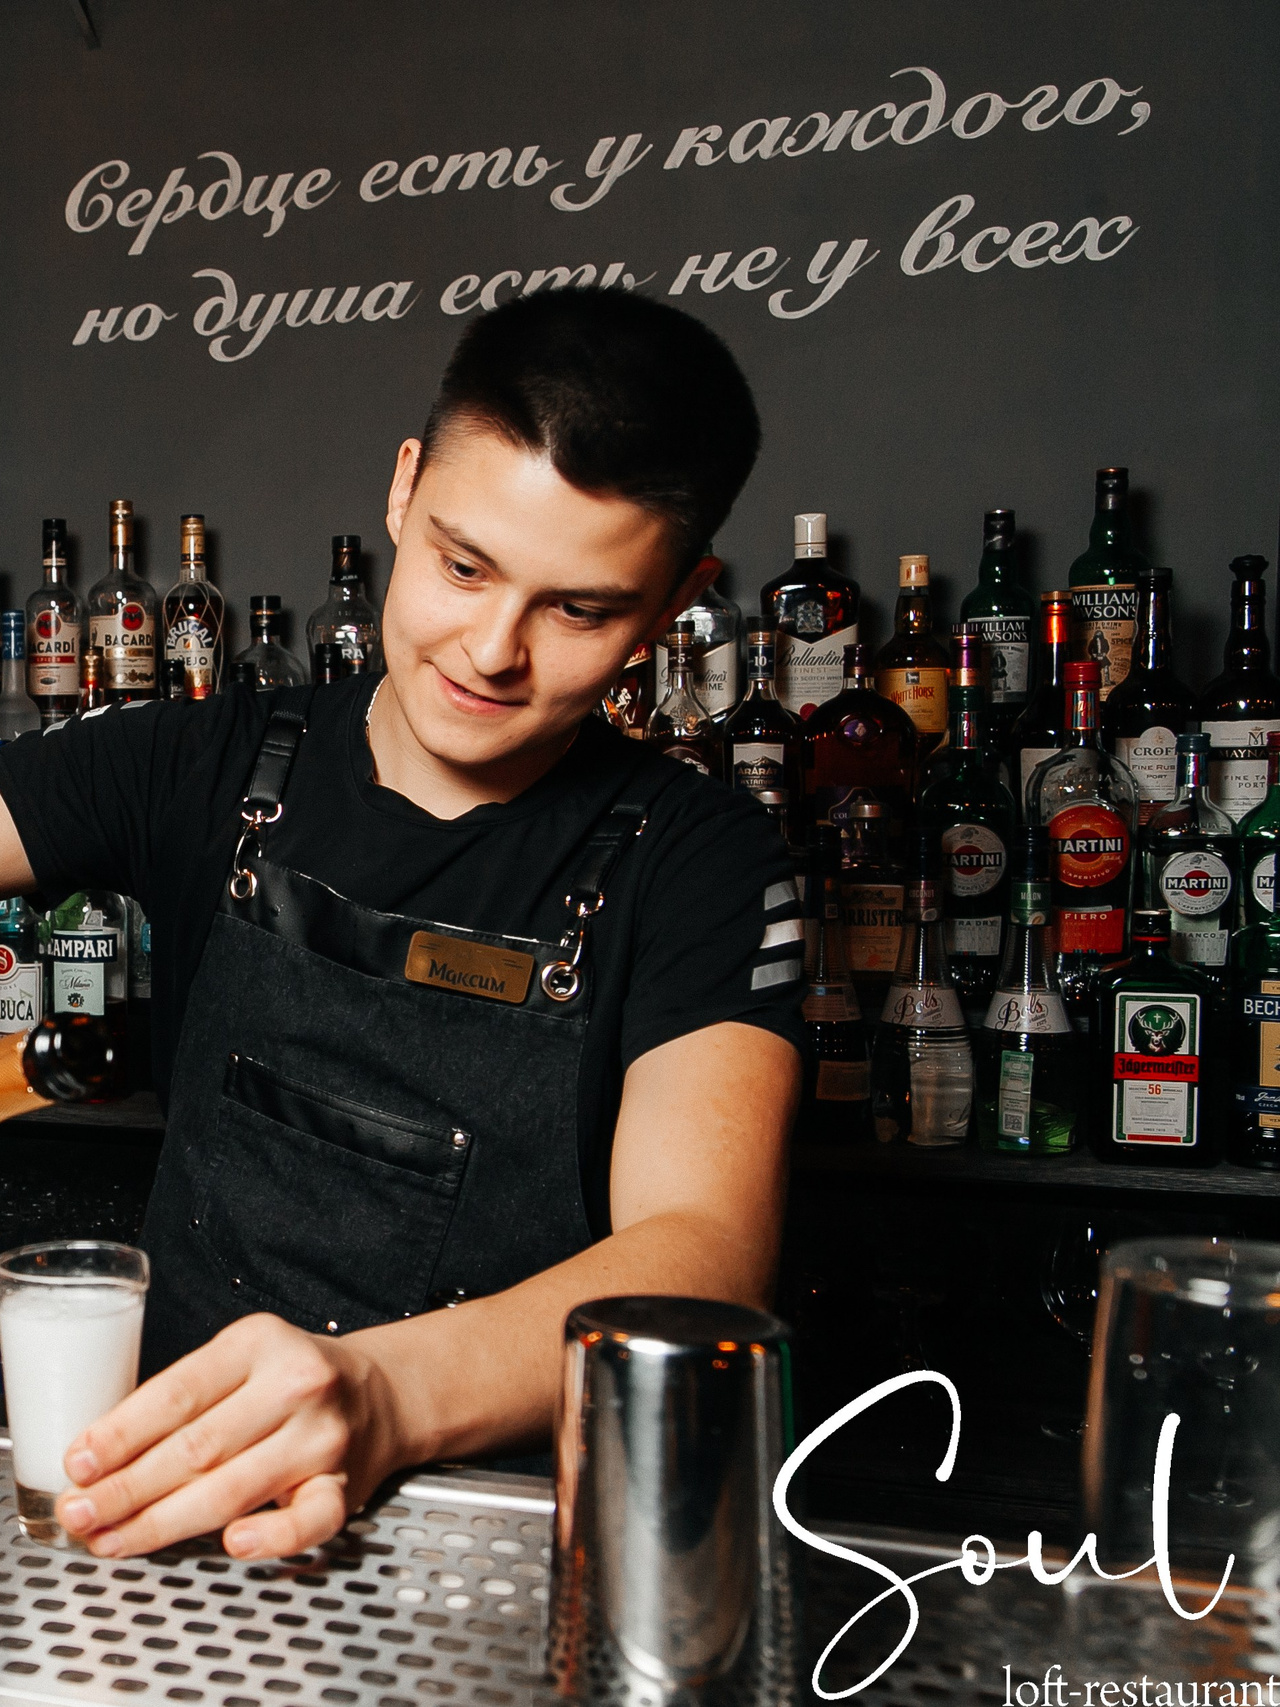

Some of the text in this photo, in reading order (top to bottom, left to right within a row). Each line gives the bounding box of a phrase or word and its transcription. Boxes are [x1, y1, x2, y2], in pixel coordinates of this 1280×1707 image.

[65, 66, 1152, 256] Сердце есть у каждого,
[73, 302, 178, 346] но
[191, 267, 423, 363] душа
[668, 246, 791, 296] не
[767, 238, 880, 320] у
[900, 194, 1141, 277] всех
[31, 637, 75, 654] ACARDÍ
[677, 652, 686, 664] 5
[753, 655, 768, 667] 10
[912, 685, 935, 700] HORSE
[1167, 877, 1227, 890] MARTINI
[1063, 913, 1109, 921] FIERO
[428, 958, 506, 994] Максим
[1147, 1083, 1161, 1095] 56
